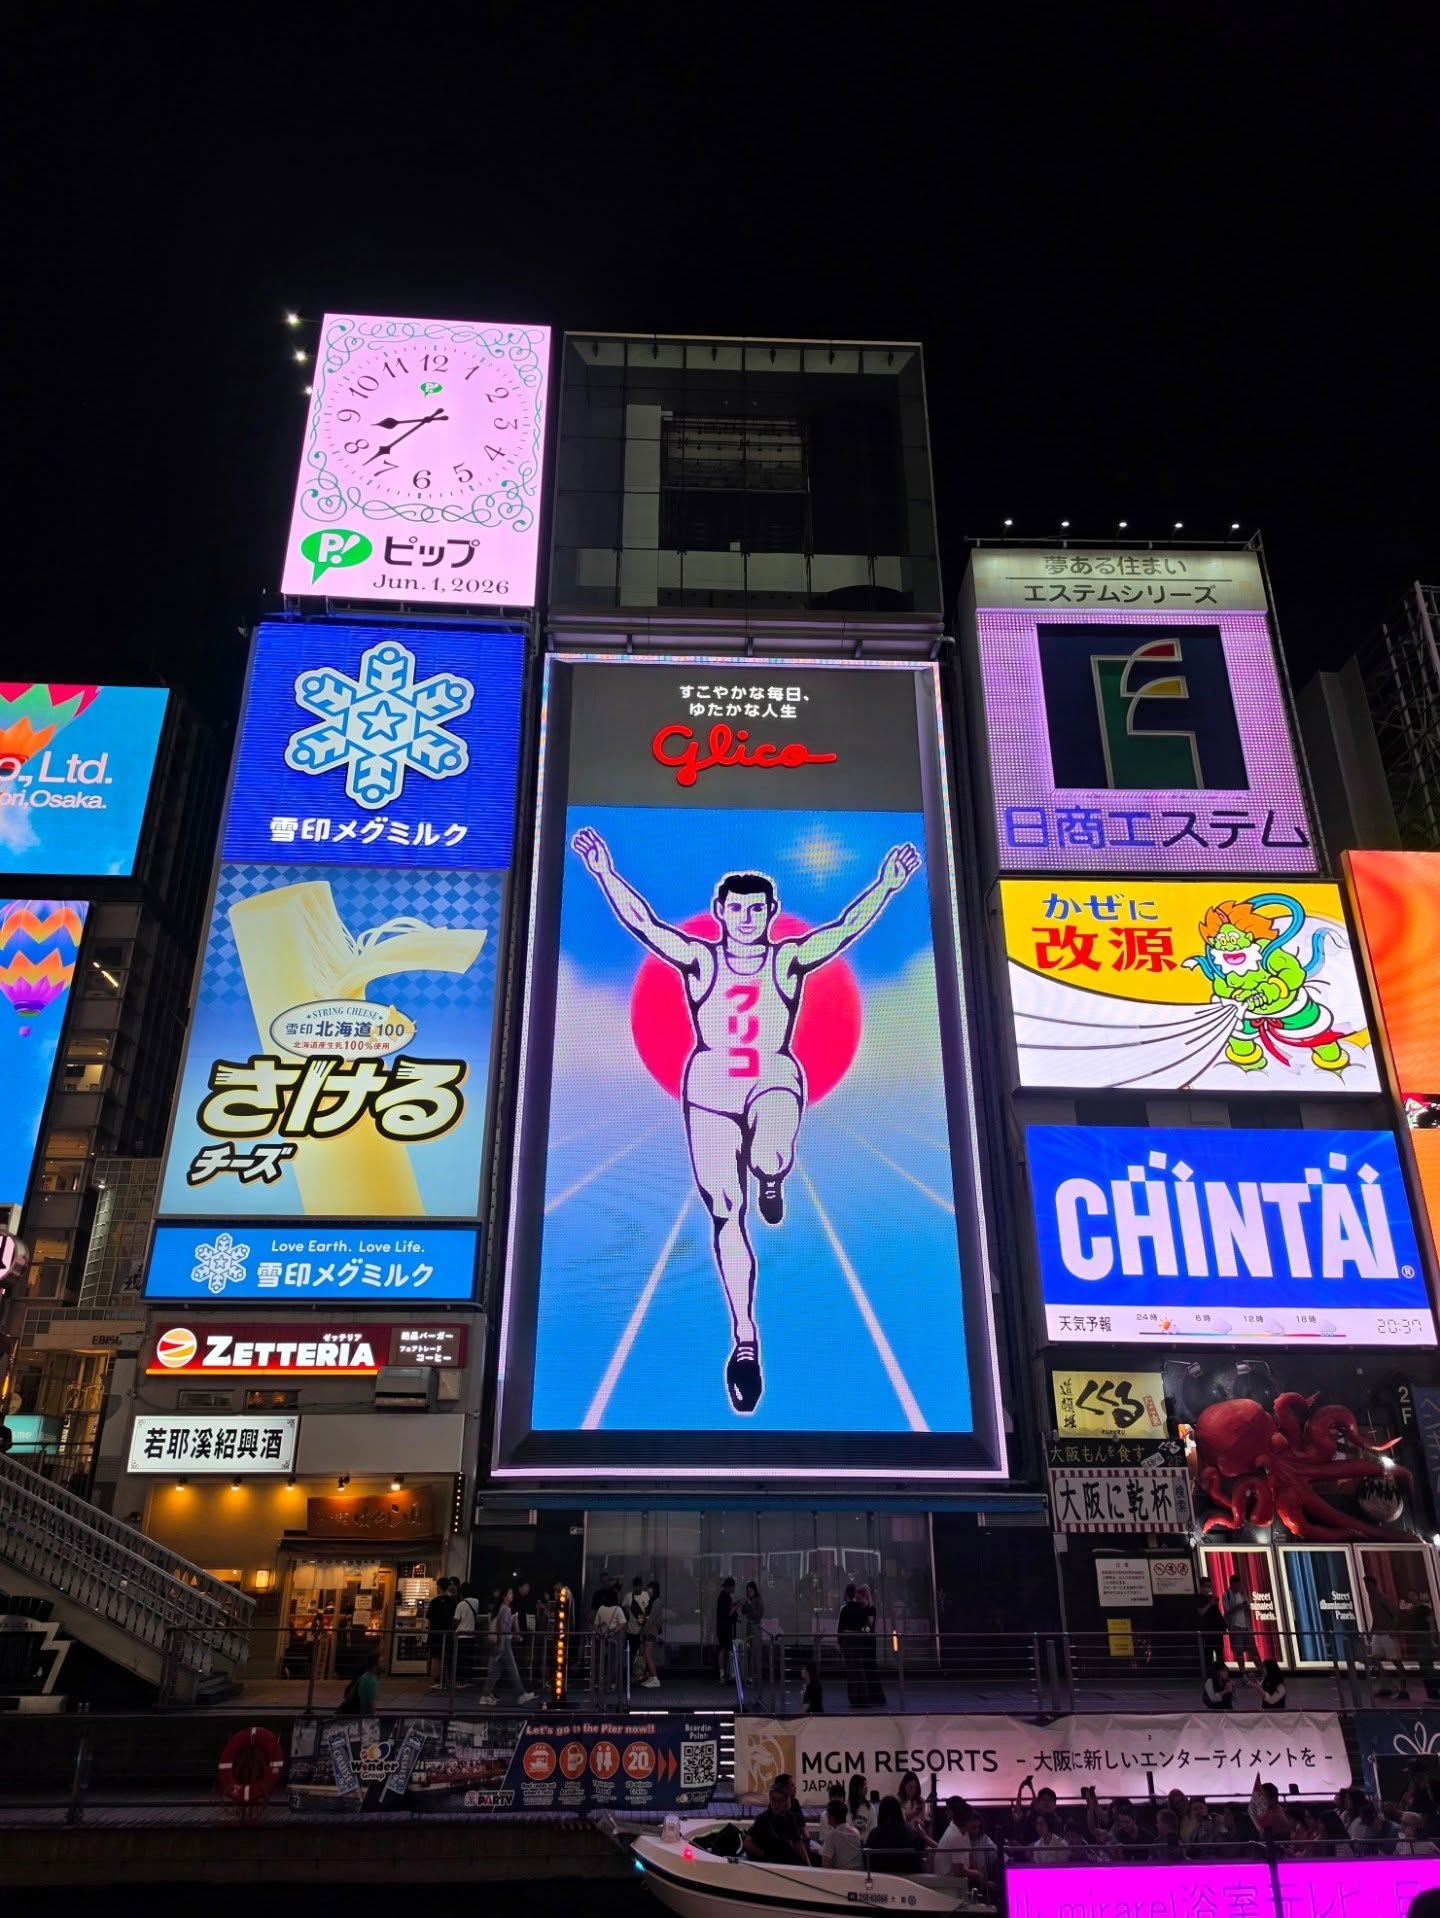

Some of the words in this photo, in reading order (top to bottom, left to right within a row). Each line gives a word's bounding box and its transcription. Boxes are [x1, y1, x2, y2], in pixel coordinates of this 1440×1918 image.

[382, 358, 409, 378] 11
[420, 354, 449, 373] 12
[464, 365, 479, 381] 1
[348, 376, 380, 400] 10
[485, 387, 510, 403] 2
[336, 408, 361, 423] 9
[493, 417, 518, 430] 3
[344, 438, 370, 454] 8
[484, 444, 506, 462] 4
[374, 460, 399, 477] 7
[453, 462, 474, 484] 5
[412, 470, 431, 489] 6
[384, 536, 480, 568] ピップ
[1044, 556, 1187, 576] 夢ある住まい
[1024, 584, 1218, 604] エステムシリーズ
[680, 685, 810, 702] すこやかな毎日、
[689, 703, 798, 719] ゆたかな人生
[652, 724, 838, 787] Glico
[269, 816, 468, 847] 雪印メグミルク
[1005, 805, 1310, 850] 日商エステム
[1042, 892, 1159, 921] かぜに
[1032, 926, 1178, 973] 改源
[312, 1006, 344, 1018] STRING
[346, 1006, 378, 1020] CHEESE
[200, 1057, 464, 1139] さける
[189, 1143, 295, 1184] チーズ
[272, 1240, 304, 1252] Love
[308, 1240, 352, 1252] Earth.
[359, 1240, 391, 1253] Love
[395, 1240, 425, 1253] Life.
[257, 1258, 434, 1288] 雪印メグミルク
[1058, 1314, 1112, 1333] 天気予報
[1136, 1313, 1158, 1322] 24時
[1195, 1314, 1212, 1322] 6時
[1243, 1315, 1264, 1324] 12時
[1296, 1316, 1316, 1324] 18時
[1377, 1318, 1422, 1335] 20:37
[322, 1334, 362, 1342] ゼッテリア
[202, 1335, 376, 1367] ZETTERIA
[400, 1345, 442, 1353] フェアトレード
[416, 1353, 452, 1362] コーヒー
[1060, 1378, 1077, 1428] 道頓堀
[1076, 1380, 1145, 1428] くくる
[144, 1428, 284, 1460] 若耶溪紹興酒
[1050, 1444, 1145, 1463] 大阪もんを食す
[1060, 1478, 1172, 1522] 大阪に乾杯
[1252, 1591, 1271, 1601] Street
[1332, 1590, 1350, 1600] Street
[526, 1725, 554, 1735] Let's
[556, 1726, 570, 1736] go
[583, 1724, 599, 1733] the
[601, 1724, 623, 1734] Pier
[628, 1752, 648, 1770] 20
[802, 1750, 866, 1774] MGM
[875, 1749, 998, 1773] RESORTS
[362, 1772, 385, 1780] Group
